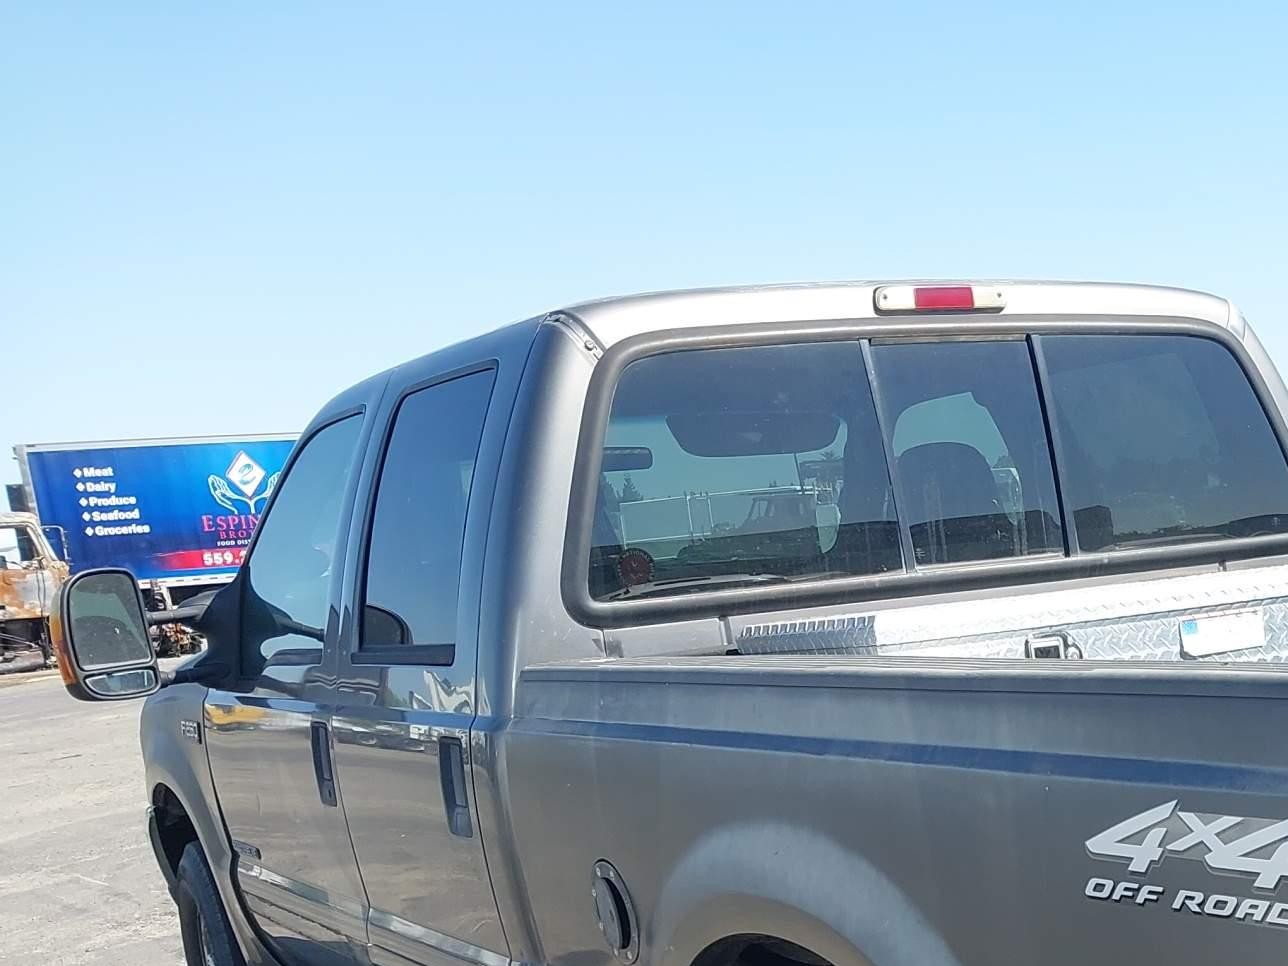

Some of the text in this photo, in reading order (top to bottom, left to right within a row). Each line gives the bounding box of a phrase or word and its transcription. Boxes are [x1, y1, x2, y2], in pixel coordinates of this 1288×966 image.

[83, 467, 114, 477] Meat
[86, 481, 117, 493] Dairy
[89, 495, 136, 507] Produce
[92, 508, 140, 521] Seafood
[95, 524, 150, 536] Groceries
[1085, 877, 1164, 904] OFF
